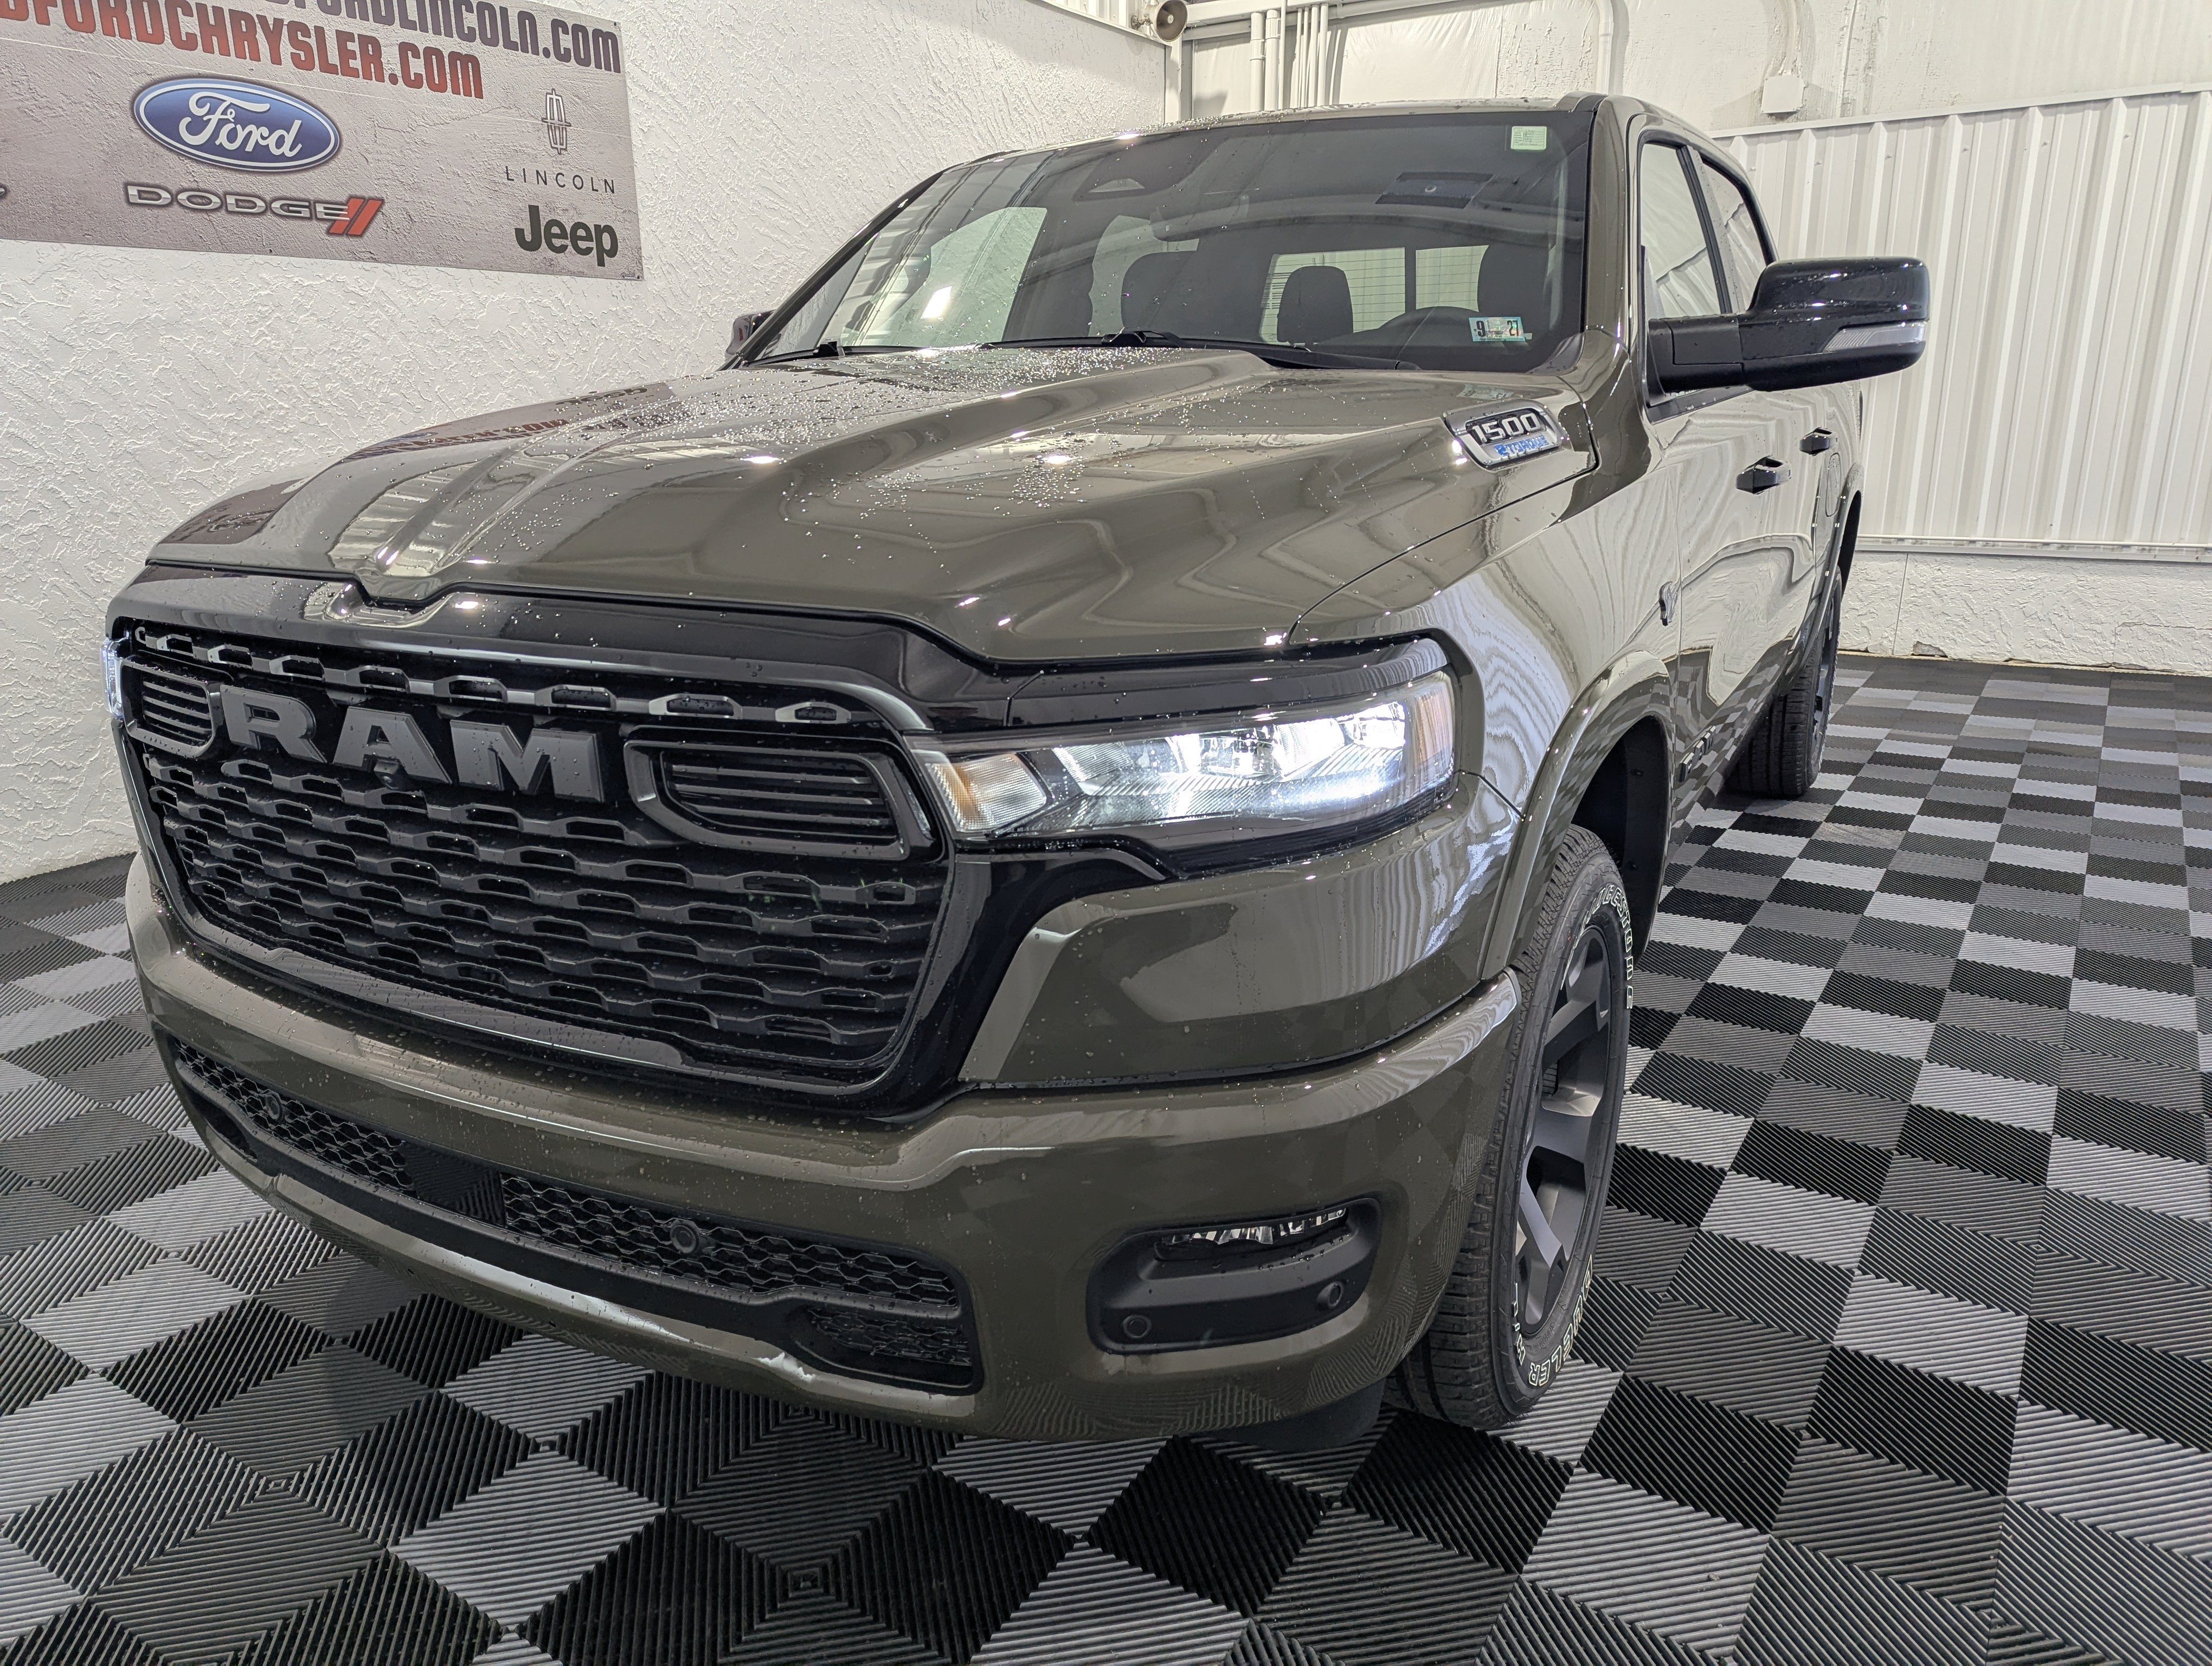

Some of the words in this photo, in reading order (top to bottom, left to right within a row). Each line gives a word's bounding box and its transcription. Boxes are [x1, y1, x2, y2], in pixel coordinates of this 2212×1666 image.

[178, 91, 303, 157] Ford
[505, 165, 615, 194] LINCOLN
[126, 185, 350, 221] DODGE
[514, 204, 619, 267] Jeep
[1476, 320, 1486, 337] 9
[1507, 320, 1519, 336] 27
[1471, 413, 1540, 443] 1500
[220, 684, 605, 803] RAM
